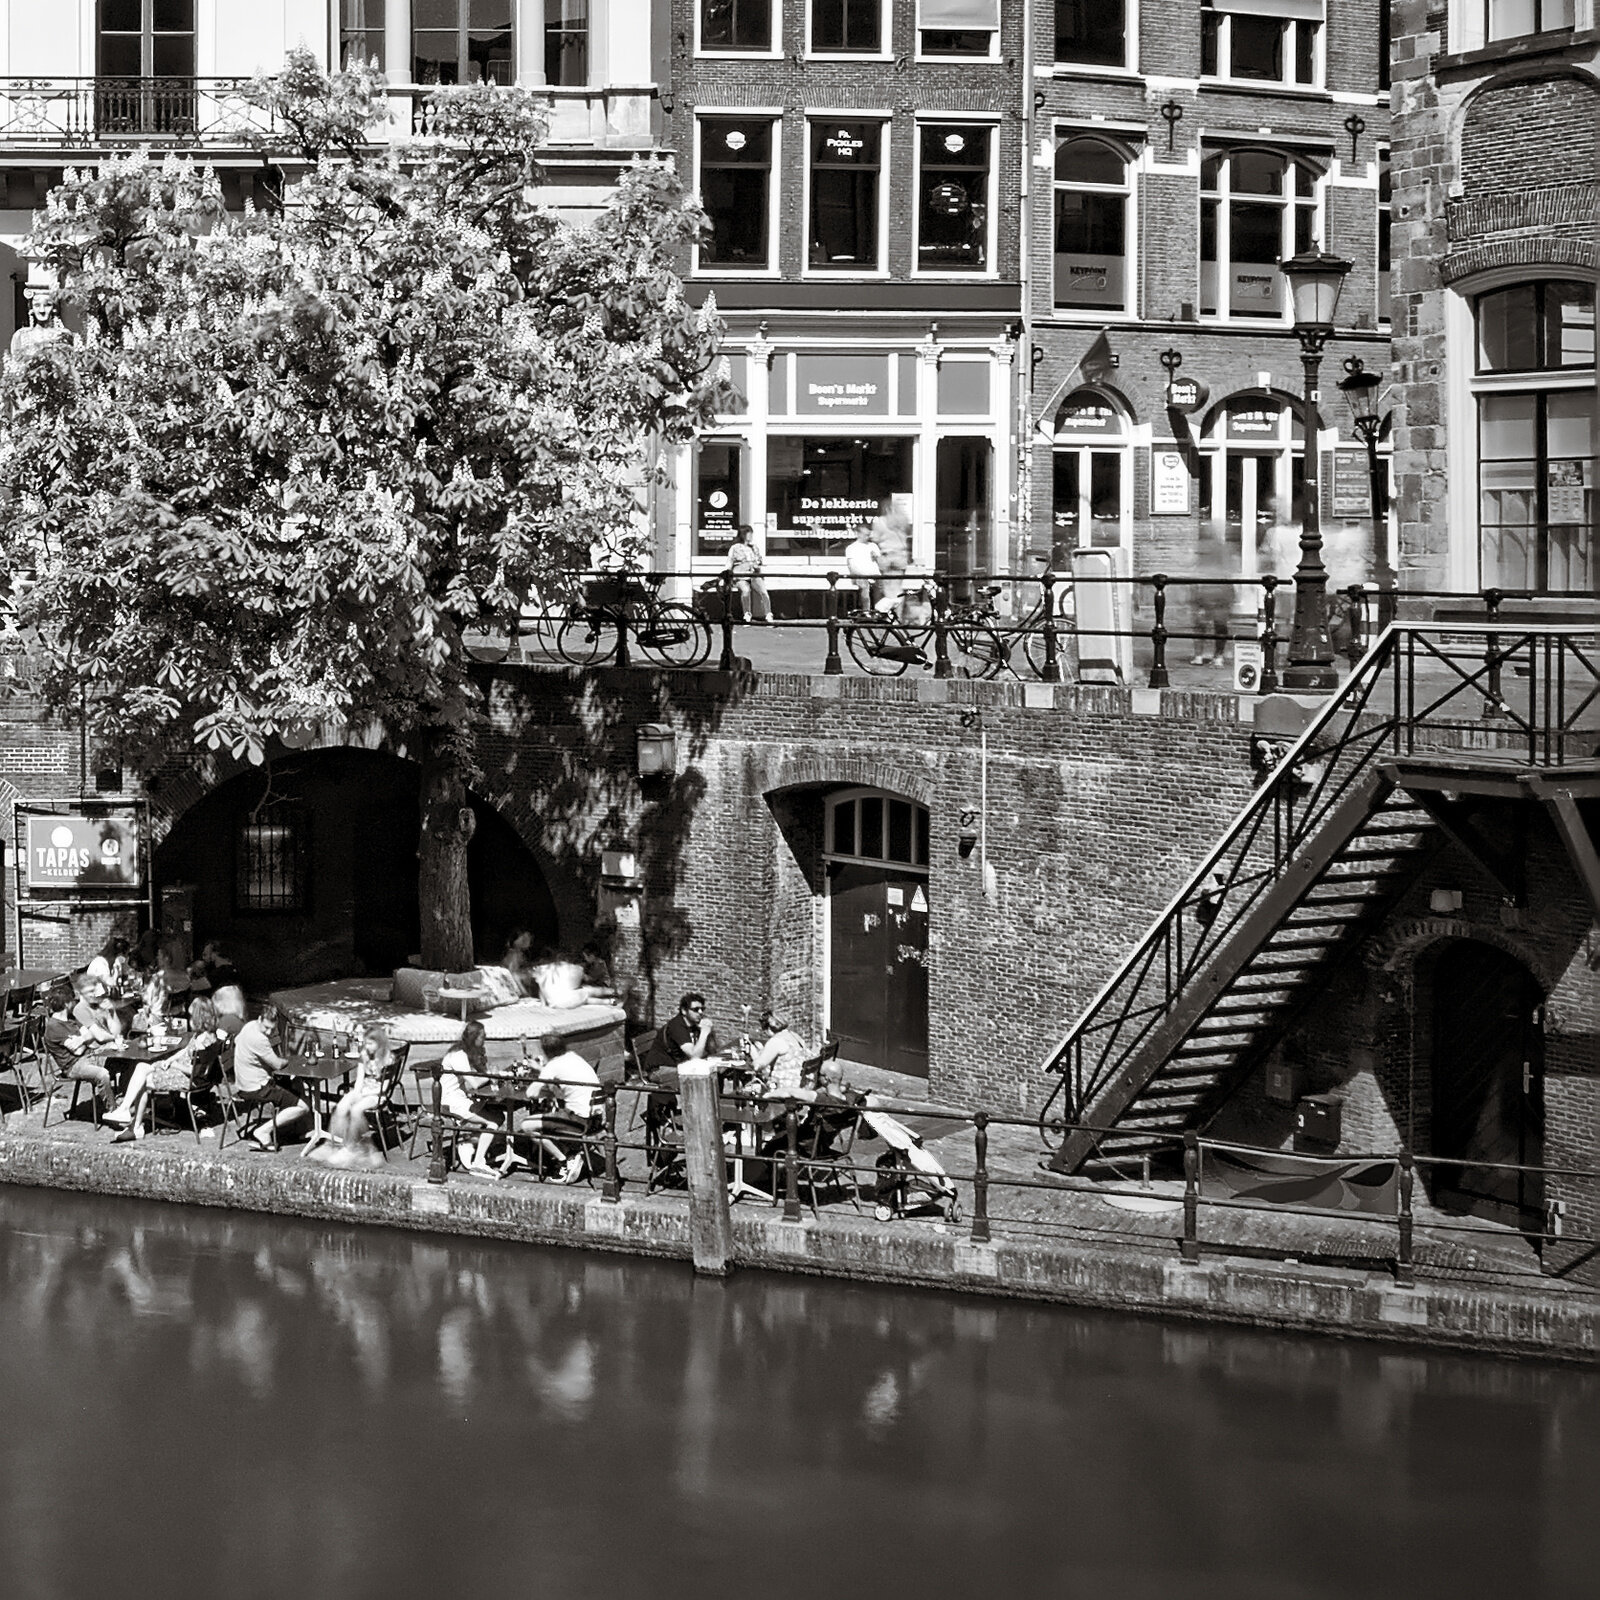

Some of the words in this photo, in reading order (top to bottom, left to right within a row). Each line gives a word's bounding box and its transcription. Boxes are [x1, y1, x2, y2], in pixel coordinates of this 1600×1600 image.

[1070, 266, 1106, 275] KEYPOINT
[1237, 275, 1272, 283] KEYPOINT
[802, 498, 819, 509] De
[821, 498, 879, 509] lekkerste
[793, 513, 863, 527] supermarkt
[36, 848, 90, 868] TAPAS
[47, 869, 79, 877] KELDER
